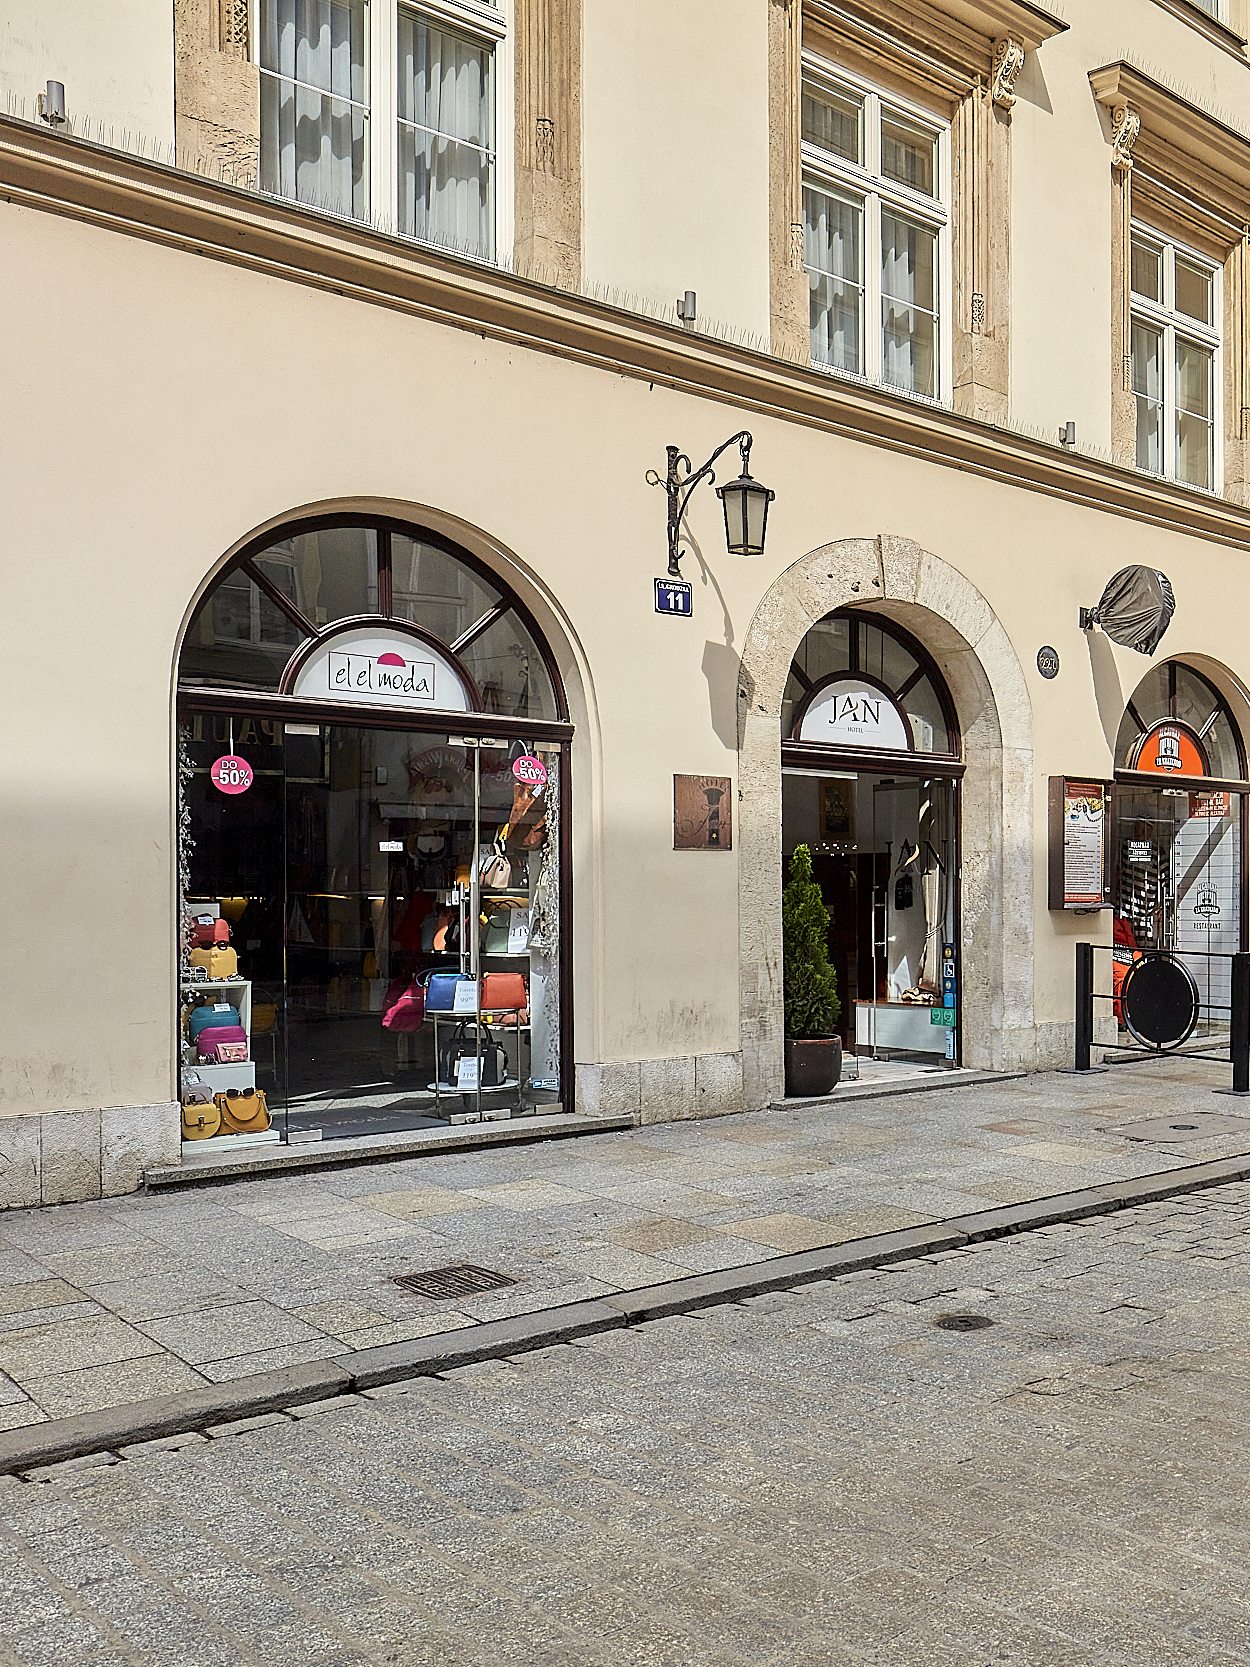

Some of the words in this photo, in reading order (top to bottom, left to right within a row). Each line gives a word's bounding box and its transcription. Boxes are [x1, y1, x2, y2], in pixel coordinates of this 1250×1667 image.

[666, 592, 683, 610] 11
[335, 657, 352, 688] el
[356, 660, 373, 689] el
[378, 665, 430, 693] moda
[828, 695, 882, 724] JAN
[847, 726, 864, 734] HOTEL
[221, 761, 237, 769] DO
[519, 759, 533, 768] DO
[212, 769, 250, 786] -50%
[515, 768, 546, 781] -50%
[698, 779, 729, 793] HOTEL
